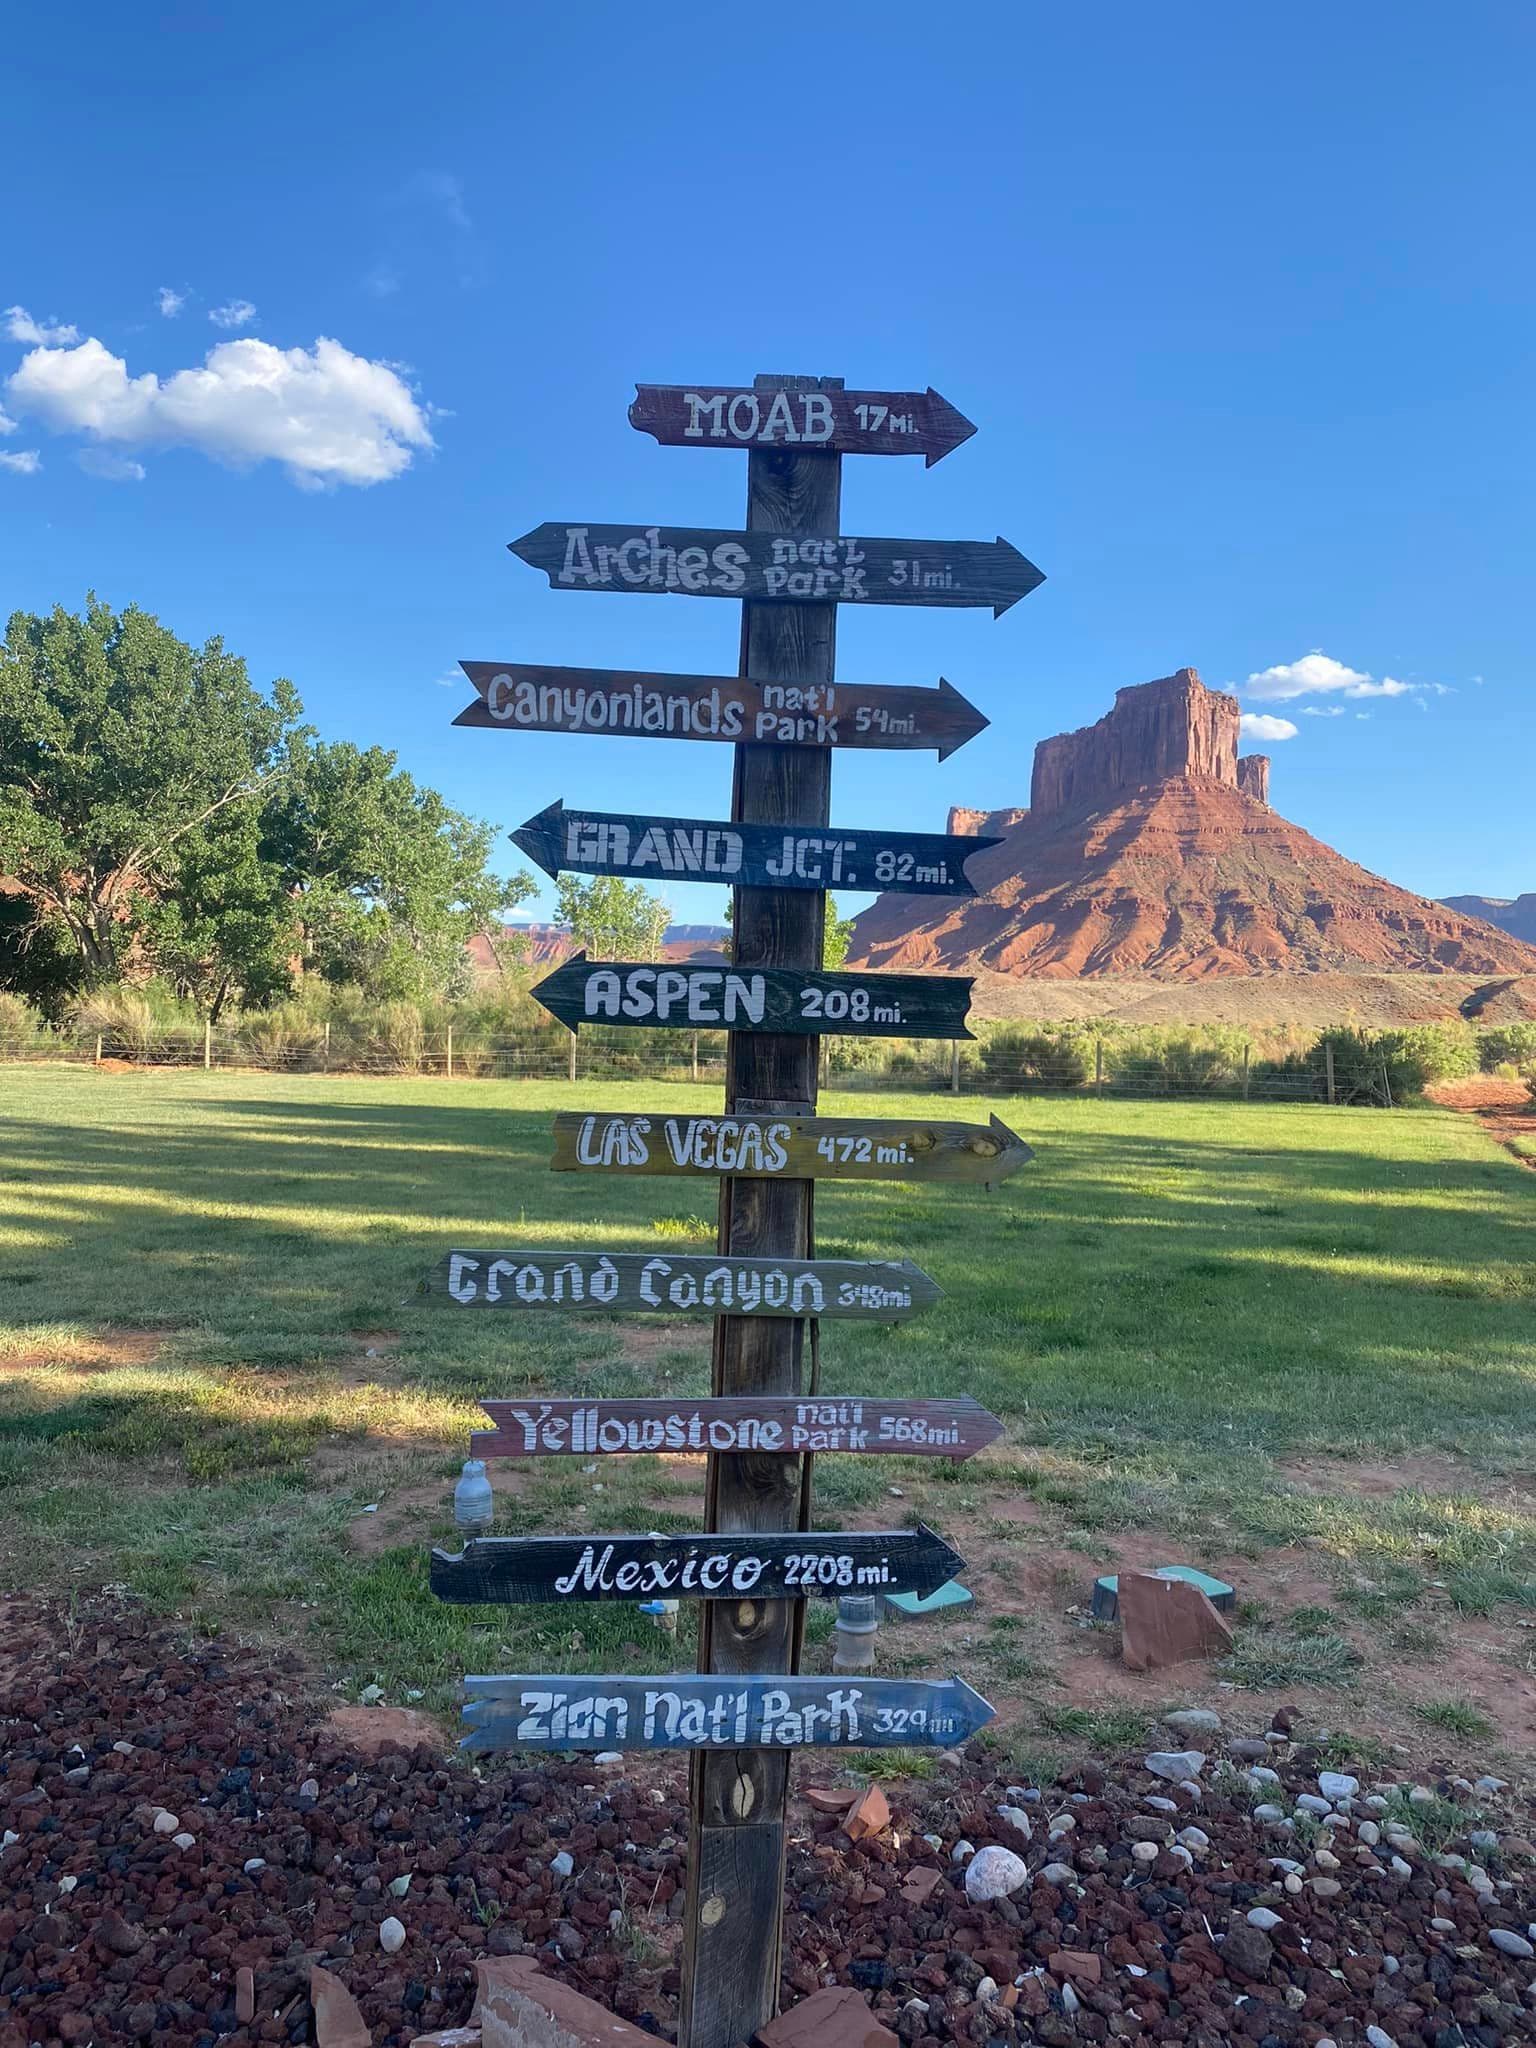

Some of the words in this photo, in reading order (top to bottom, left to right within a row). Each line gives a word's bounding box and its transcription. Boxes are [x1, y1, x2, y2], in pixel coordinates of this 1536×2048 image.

[684, 393, 836, 442] MOAB
[558, 528, 751, 590] Arches
[487, 673, 745, 736] Canyonlands
[566, 822, 744, 873] GRAND
[765, 836, 857, 882] JCT.
[585, 968, 766, 1023] ASPEN
[576, 1116, 652, 1166] LAS
[664, 1119, 791, 1172] VEGAS
[448, 1254, 619, 1304] Grand
[640, 1258, 827, 1312] Canyon
[511, 1405, 785, 1452] Yellowstone
[554, 1544, 772, 1593] Mexico
[517, 1691, 628, 1740] Zion
